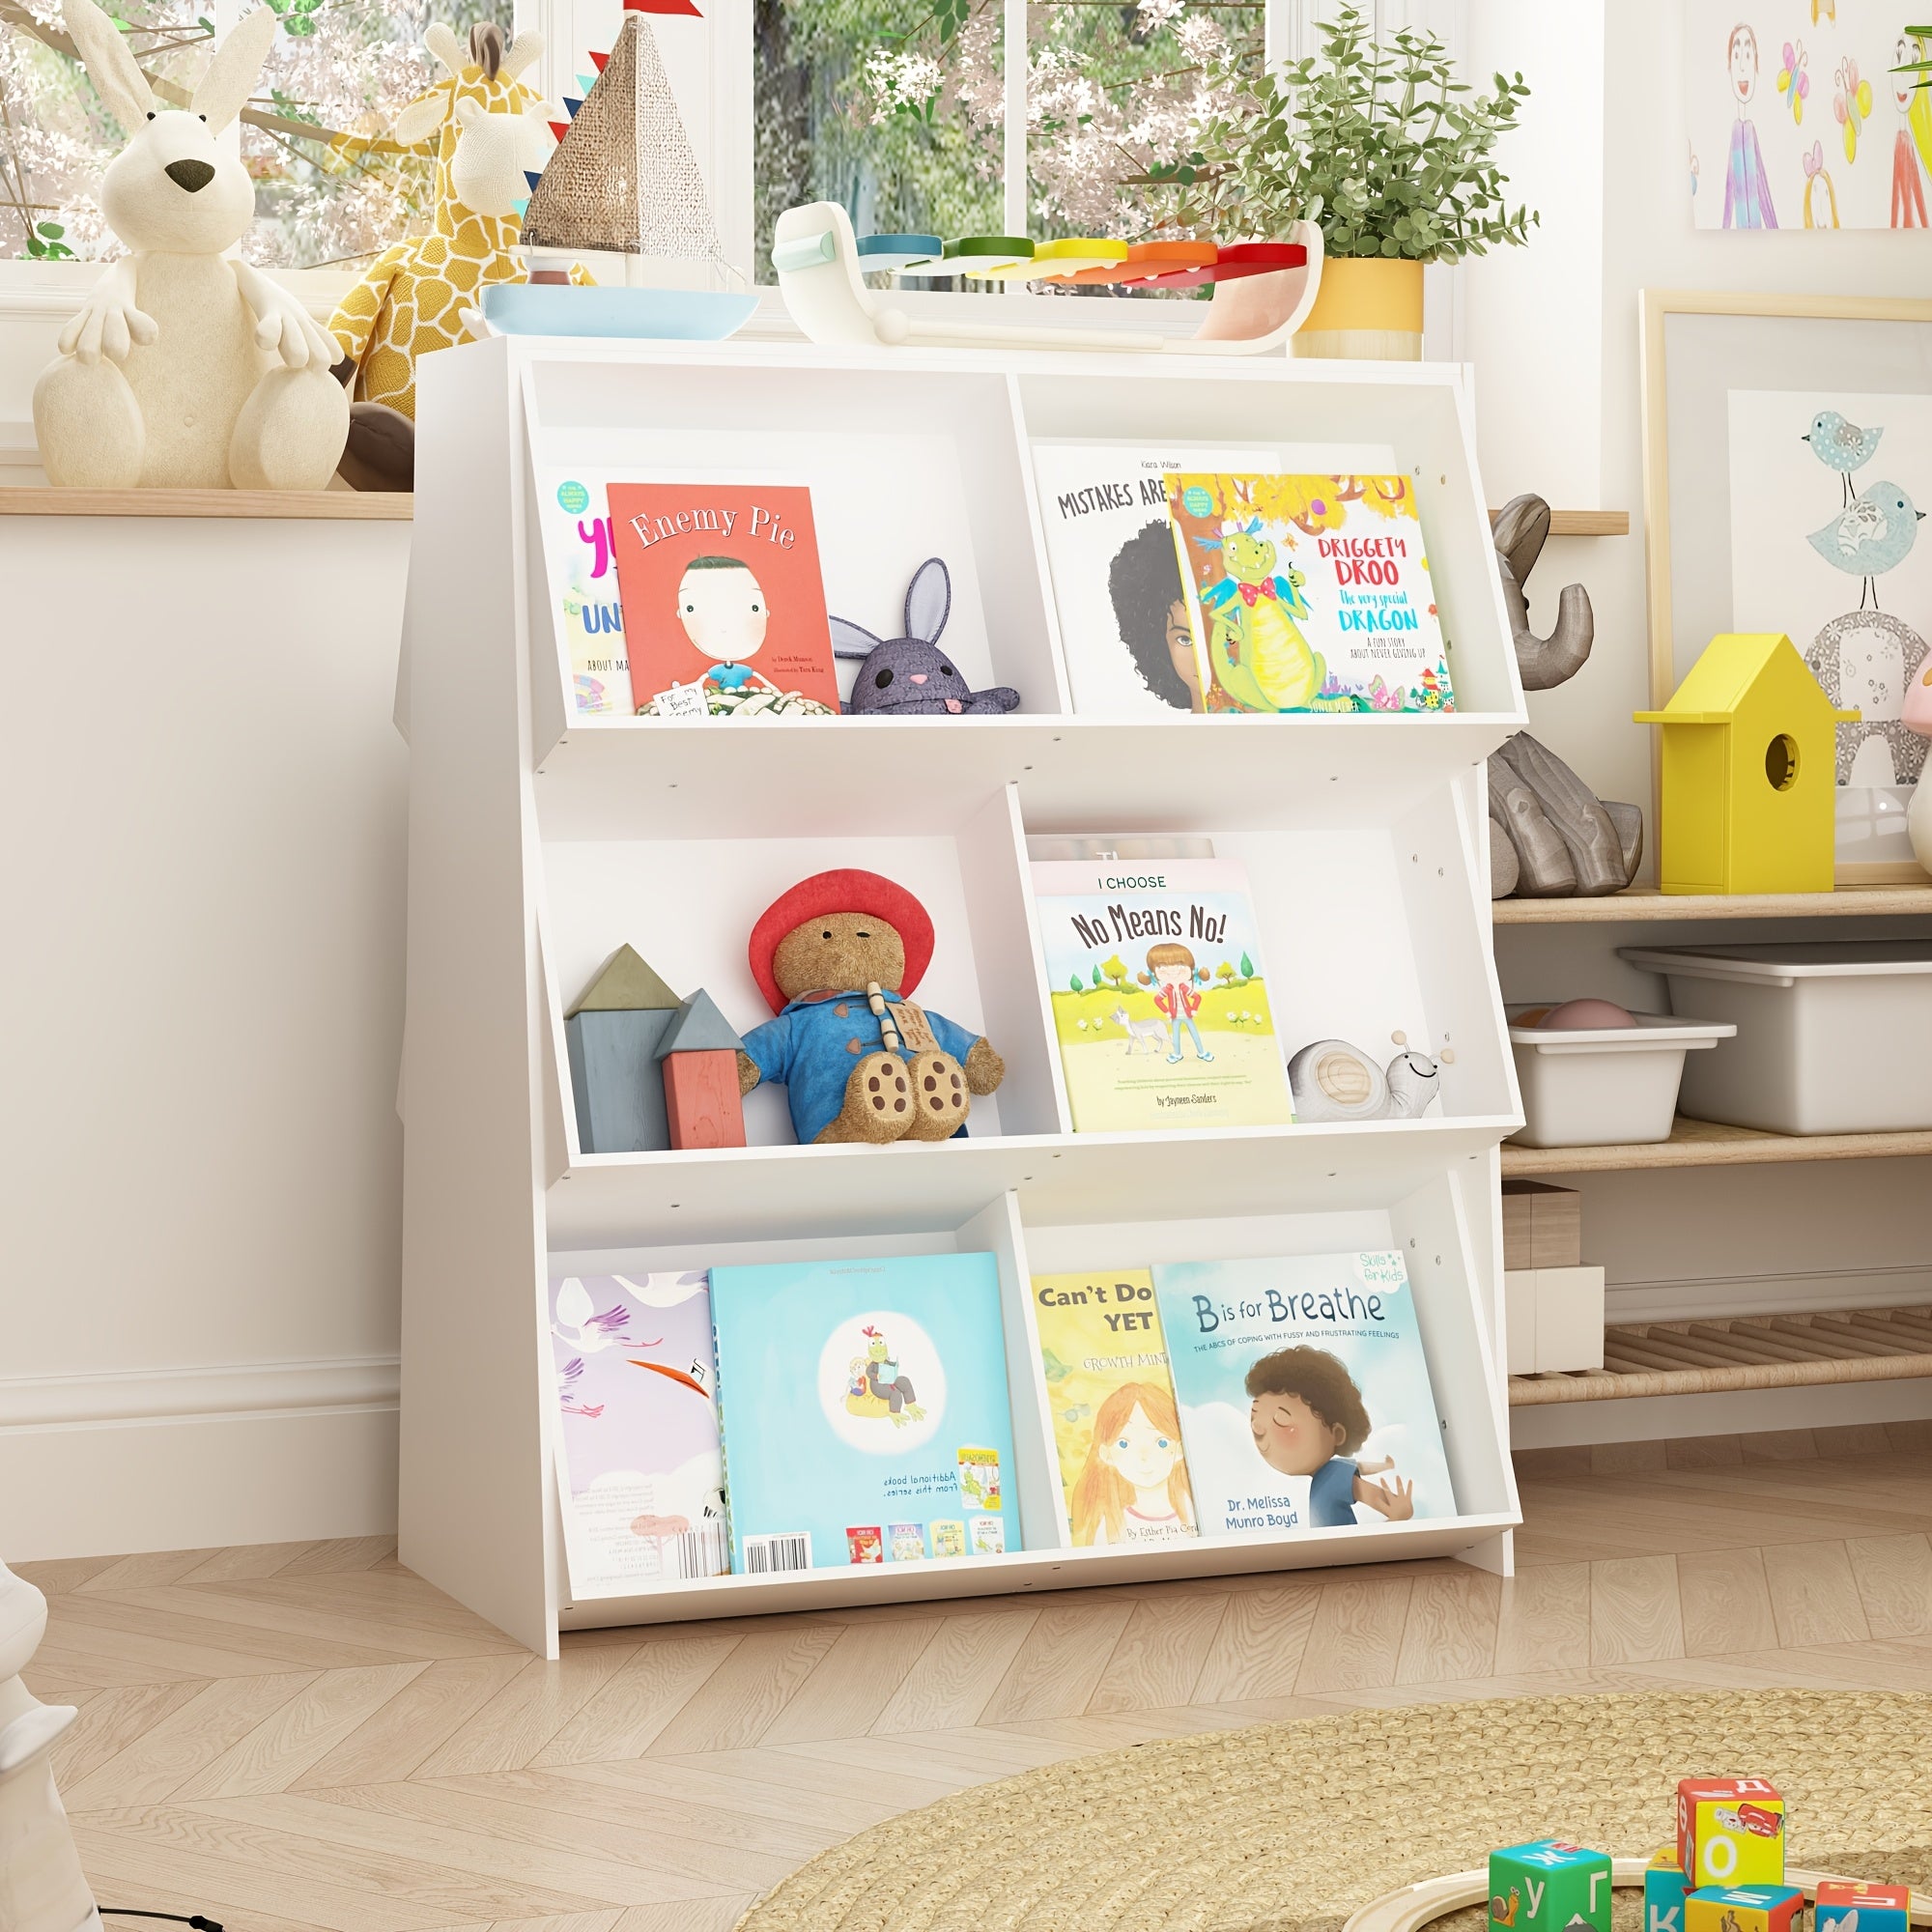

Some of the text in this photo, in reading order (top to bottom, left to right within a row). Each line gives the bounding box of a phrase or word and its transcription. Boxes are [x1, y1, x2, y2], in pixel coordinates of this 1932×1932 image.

[1058, 479, 1167, 519] MISTAKES ARE
[629, 505, 795, 550] Enemy Pie
[1318, 537, 1406, 557] DRIGGETY
[1335, 559, 1399, 585] DROO
[1339, 589, 1407, 609] The very special
[582, 603, 621, 633] UN
[1339, 609, 1418, 633] DRAGON
[1368, 638, 1405, 647] A FUN STORY
[1350, 648, 1426, 658] ABOUT NEVER GIVING UP
[588, 660, 611, 670] ABOUT
[1098, 876, 1166, 889] I CHOOSE
[1070, 904, 1227, 949] No Means No!
[1156, 1095, 1164, 1107] by
[1191, 1093, 1217, 1104] Sanders
[1360, 1253, 1386, 1267] Skills
[1364, 1267, 1404, 1283] for Kids
[1038, 1284, 1152, 1307] Can't Do
[1192, 1288, 1385, 1332] B is for Breathe
[1104, 1312, 1153, 1332] YET
[1194, 1344, 1208, 1352] THE
[1208, 1340, 1226, 1350] ABCS
[1237, 1335, 1263, 1344] COPING
[1368, 1330, 1400, 1339] FEELINGS
[1083, 1354, 1133, 1371] GROWTH
[1227, 1496, 1291, 1511] Dr. Melissa
[1226, 1512, 1298, 1529] Munro Boyd
[1140, 1526, 1163, 1536] Esther
[1520, 1850, 1578, 1865] Ж
[1590, 1870, 1608, 1913] Г
